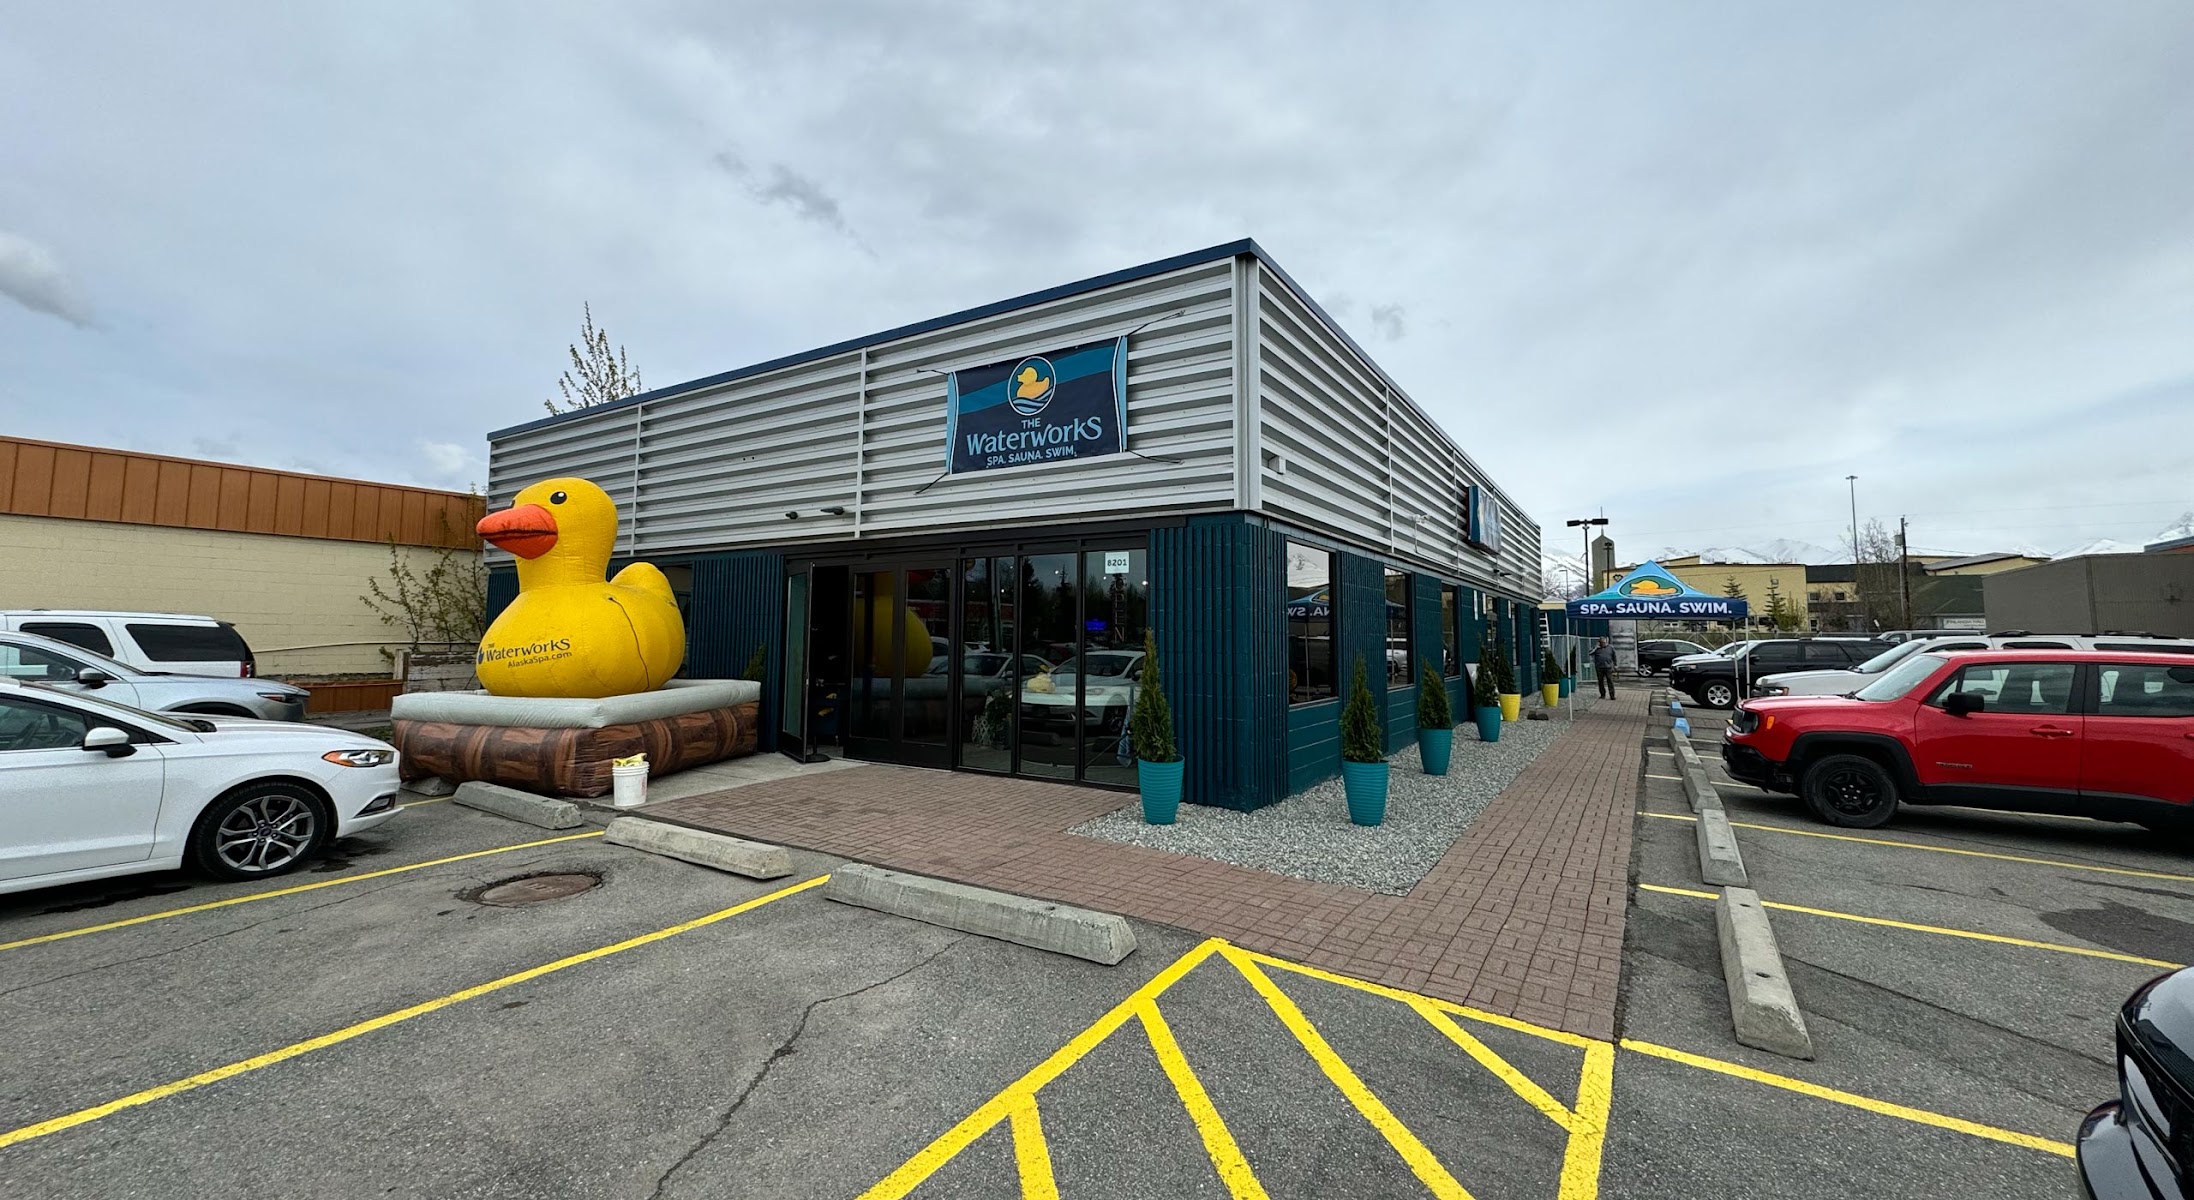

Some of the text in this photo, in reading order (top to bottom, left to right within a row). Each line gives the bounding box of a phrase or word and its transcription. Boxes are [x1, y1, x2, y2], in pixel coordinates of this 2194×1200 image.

[1021, 417, 1041, 429] THE
[986, 445, 1077, 467] SPA. SAUNA. SWIM.
[1114, 576, 1125, 643] OPEN
[1580, 602, 1732, 614] SPA. SAUNA. SWIM.
[508, 651, 572, 668] AlaskaSpa.com
